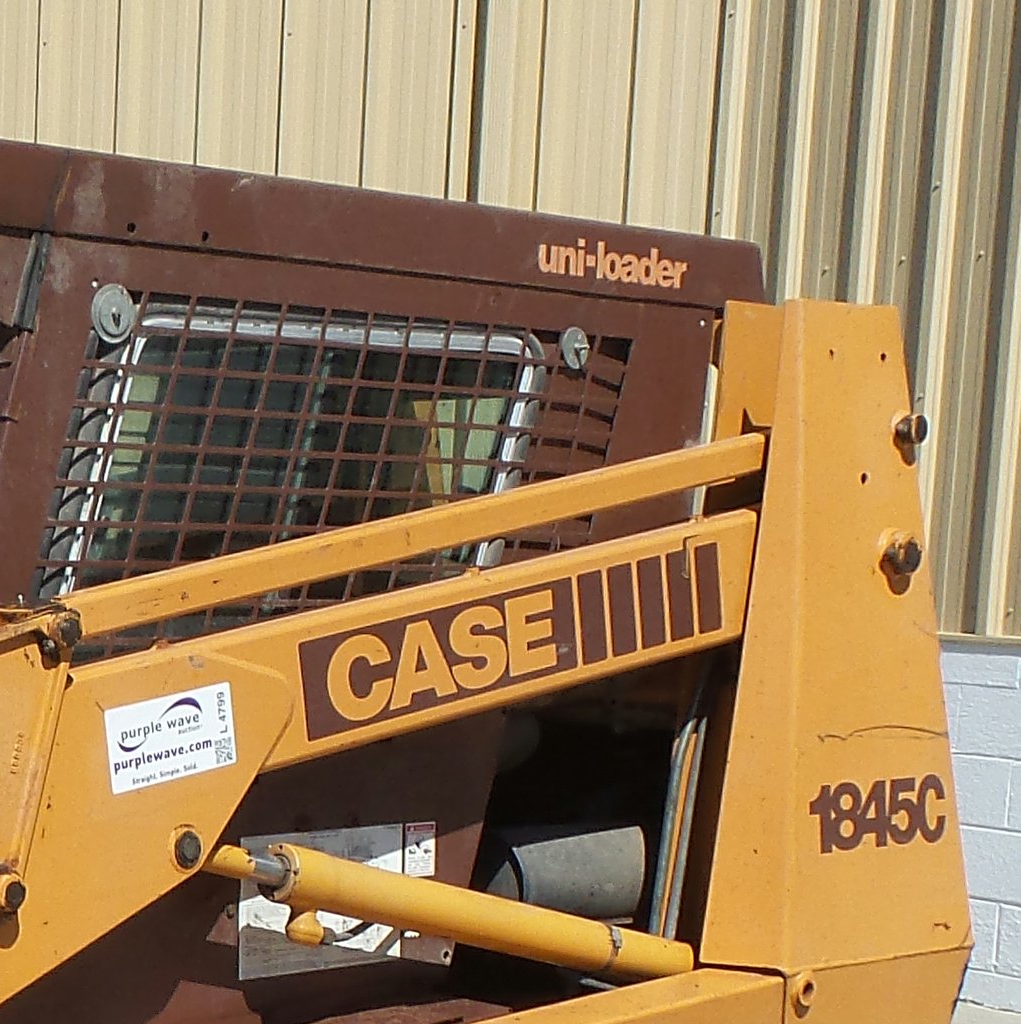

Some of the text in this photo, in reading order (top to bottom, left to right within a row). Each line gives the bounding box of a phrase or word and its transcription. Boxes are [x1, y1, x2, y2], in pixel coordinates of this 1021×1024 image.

[538, 238, 688, 289] uni-loader
[327, 588, 558, 722] CASE
[121, 713, 200, 743] purple wave
[216, 691, 228, 734] L 4799
[114, 739, 212, 775] purplewave.com
[809, 773, 946, 854] 1845C
